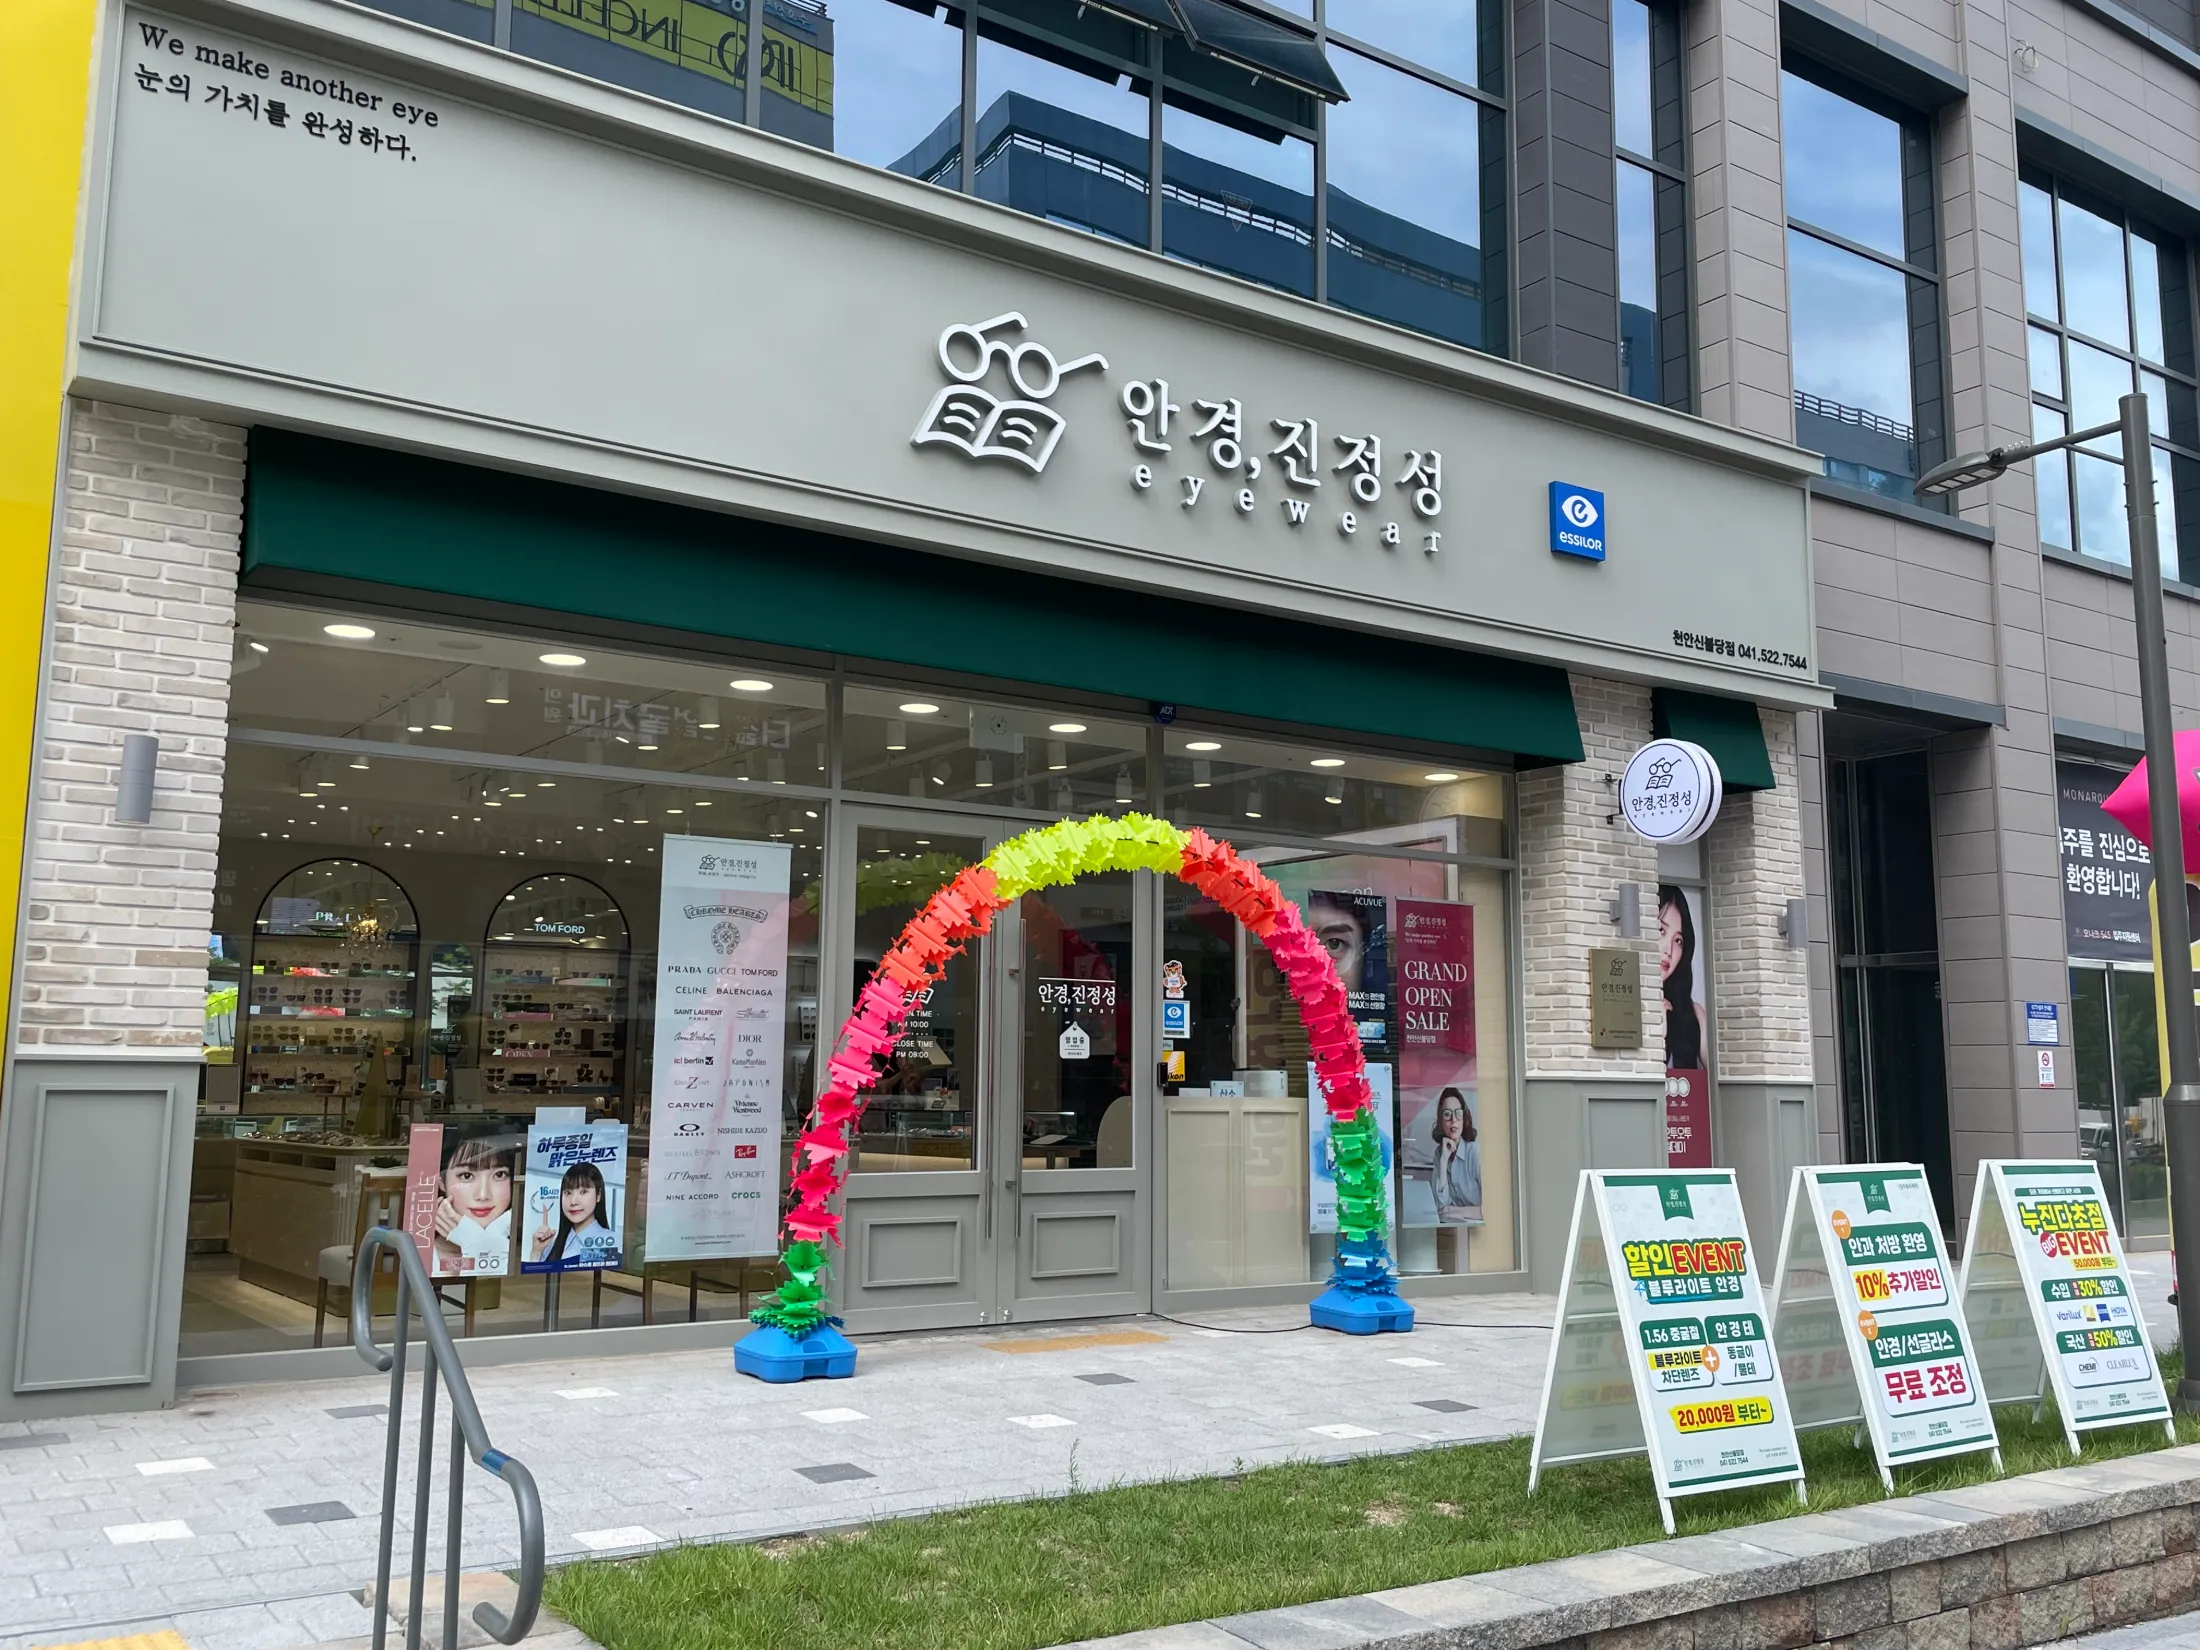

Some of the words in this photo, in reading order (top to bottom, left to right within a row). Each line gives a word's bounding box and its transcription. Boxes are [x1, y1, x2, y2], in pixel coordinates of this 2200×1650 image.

[138, 22, 185, 55] We
[194, 43, 270, 80] make
[280, 68, 383, 111] another
[391, 100, 439, 128] eye
[134, 63, 191, 103] 눈의
[204, 84, 291, 129] 가치를
[302, 110, 418, 162] 완성하다.
[1119, 378, 1443, 519] 안경,진정성
[1672, 629, 1736, 657] 천안신불당점
[1738, 643, 1808, 670] 041.522.7544
[1632, 790, 1692, 812] 안경,진정성
[2066, 863, 2141, 900] 환영합니다!
[1353, 897, 1384, 907] ACUVUE
[534, 923, 556, 933] TOM
[557, 924, 585, 934] FORD
[667, 965, 702, 974] PRADA
[707, 967, 737, 976] GUCCI
[741, 968, 757, 976] TOM
[757, 969, 778, 977] FORD
[1404, 960, 1467, 983] GRAND
[675, 986, 707, 995] CELINE
[717, 988, 773, 997] BALENCIAGA
[1038, 984, 1116, 1006] 안경,진정성
[1405, 987, 1452, 1007] OPEN
[1405, 1011, 1450, 1031] SALE
[738, 1034, 762, 1043] DIOR
[723, 1079, 770, 1087] JAPONISM
[536, 1133, 593, 1154] 하루종일
[725, 1171, 765, 1179] ASHCROFT
[731, 1191, 761, 1199] crocs
[416, 1175, 436, 1249] LACELLE
[2019, 1203, 2106, 1232] 누진다초점
[1848, 1236, 1875, 1258] 안과
[1875, 1234, 1901, 1255] 처방
[1903, 1232, 1928, 1253] 환영
[2041, 1236, 2056, 1254] BIG
[2055, 1231, 2111, 1256] EVENT
[1648, 1278, 1712, 1297] 블루라이트
[1716, 1276, 1740, 1293] 안경
[2051, 1282, 2071, 1299] 수입
[1645, 1328, 1669, 1344] 1.56
[1671, 1325, 1700, 1341] 중굴절
[1875, 1330, 1955, 1359] 안경/선글라스
[2064, 1334, 2086, 1349] 국산
[1654, 1350, 1703, 1368] 블루라이트
[1662, 1367, 1701, 1384] 차단렌즈
[1885, 1369, 1927, 1403] 무료
[1927, 1363, 1967, 1397] 조정
[1677, 1404, 1736, 1428] 20,000원
